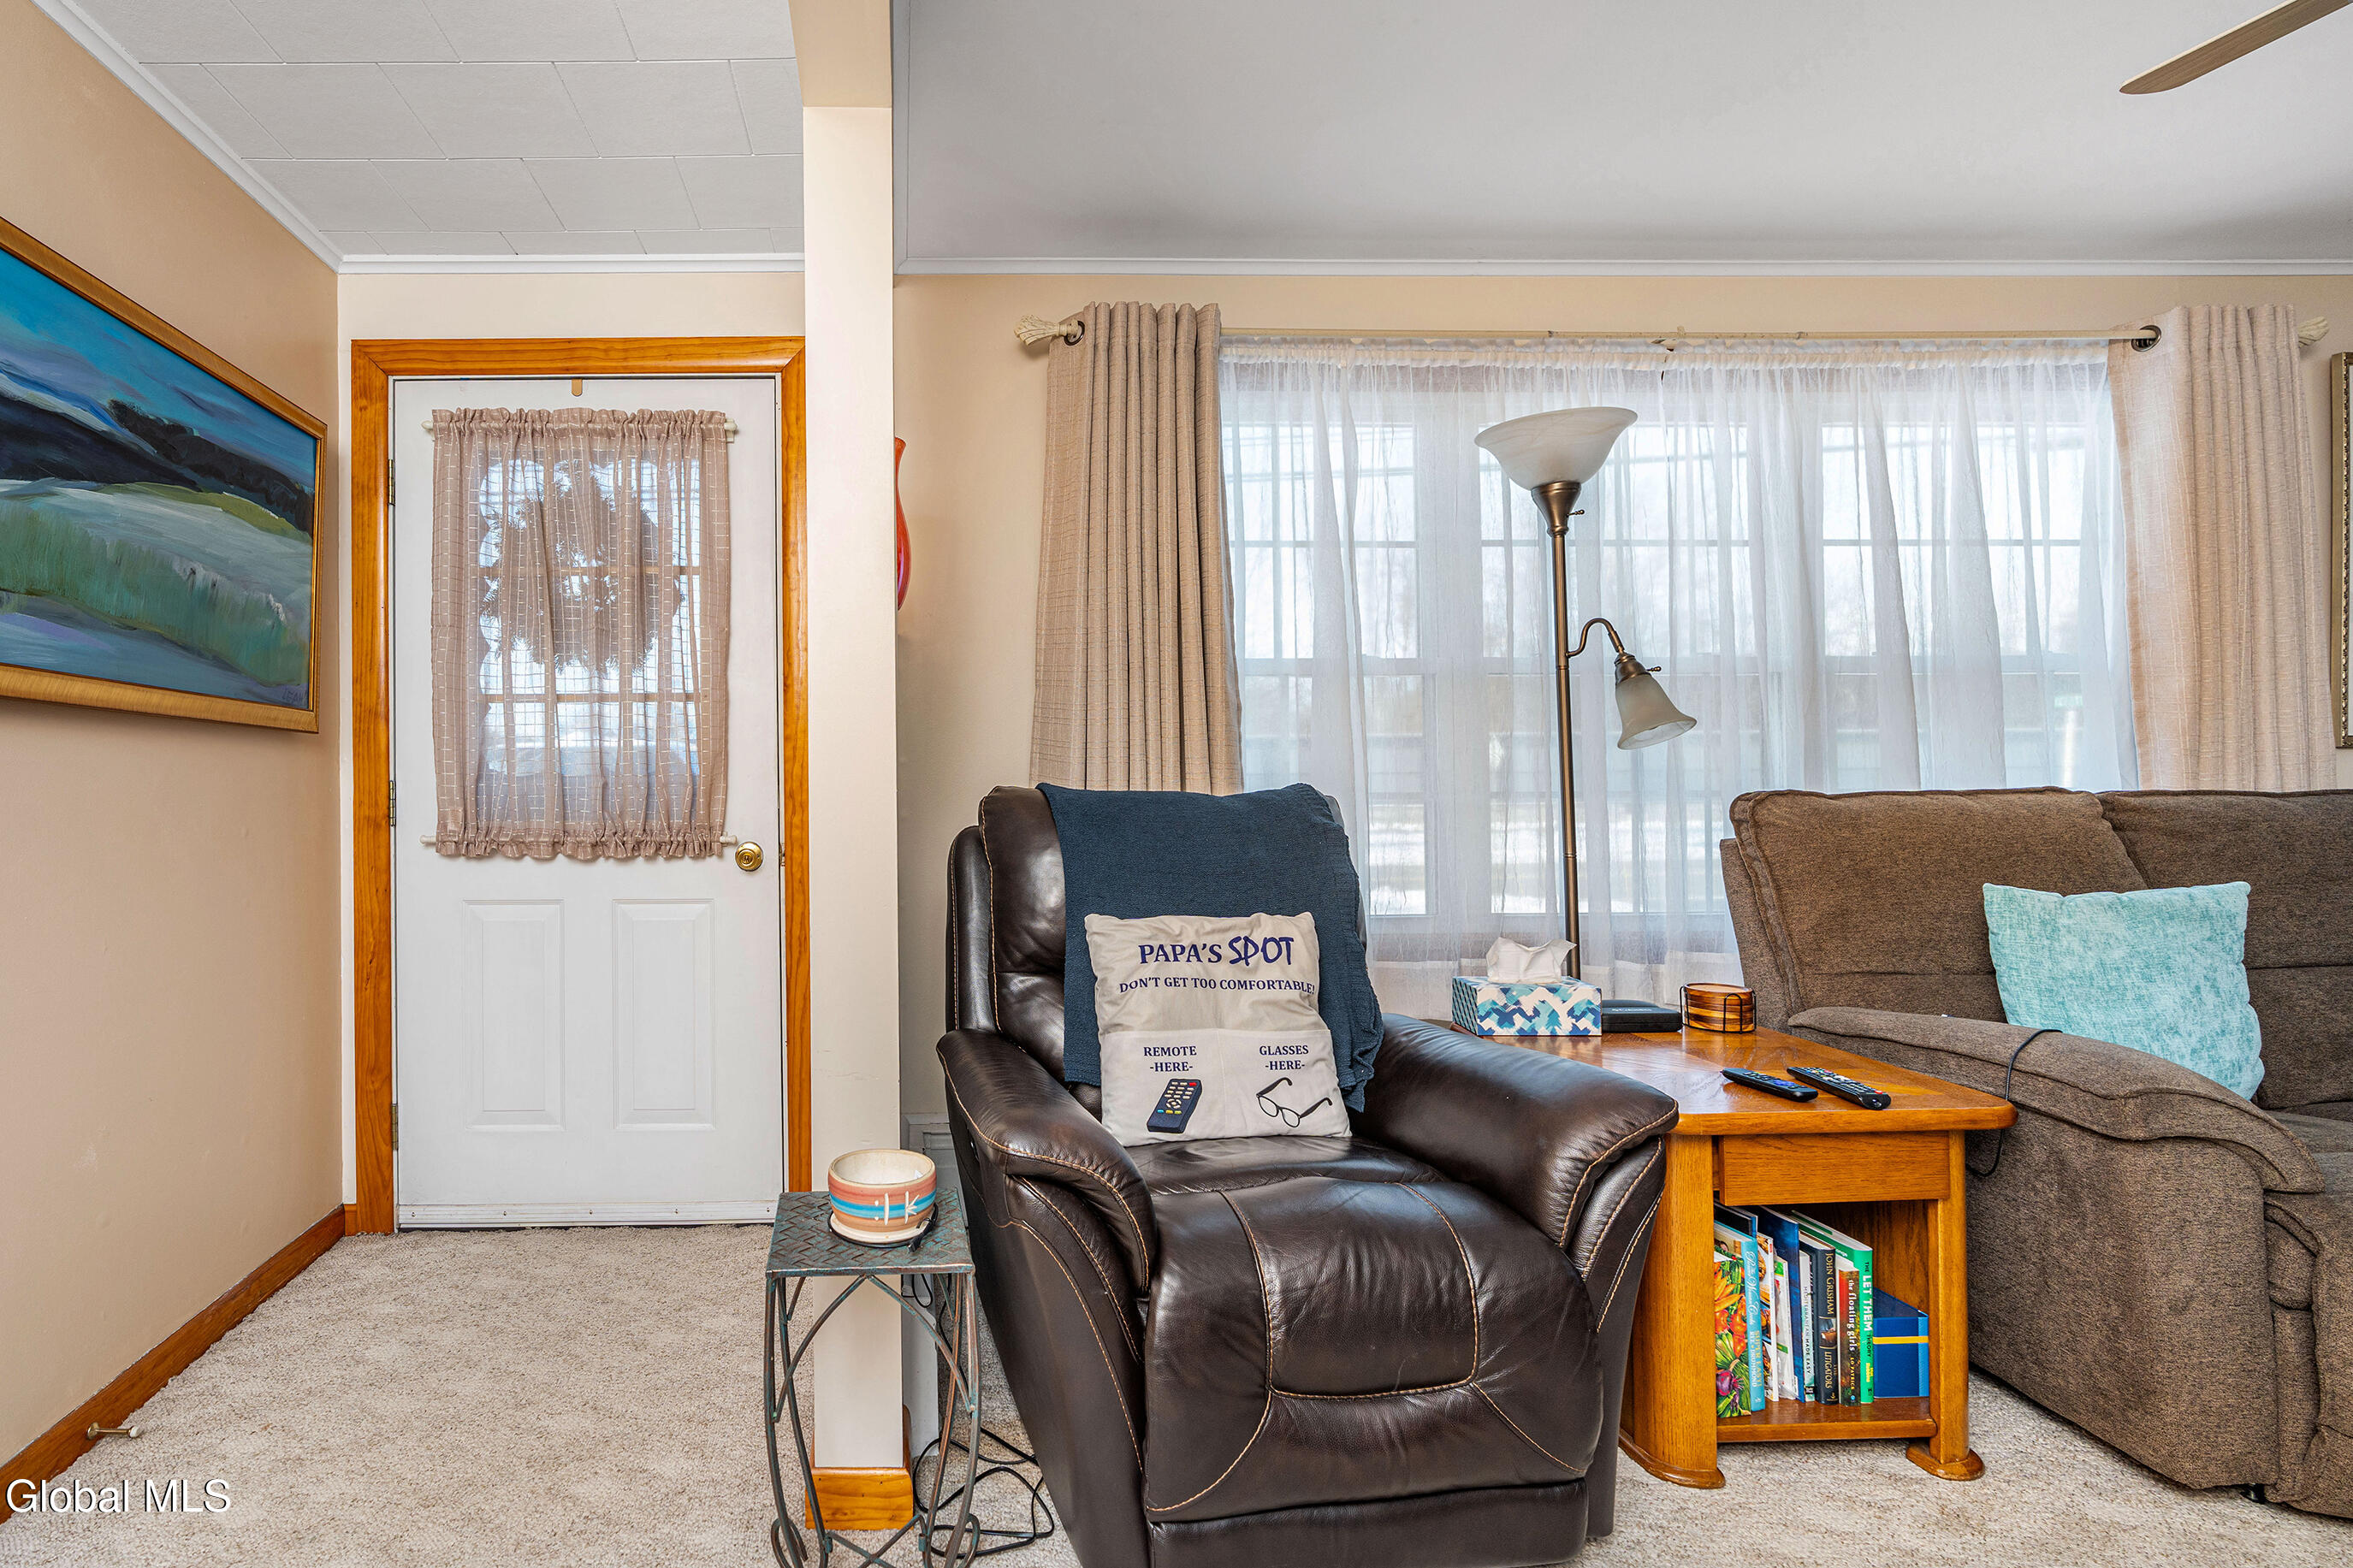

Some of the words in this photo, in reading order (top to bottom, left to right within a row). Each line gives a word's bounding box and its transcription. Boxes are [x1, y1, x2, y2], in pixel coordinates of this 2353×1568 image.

[1138, 944, 1222, 964] PAPA'S
[1228, 936, 1295, 966] SPOT
[1119, 977, 1160, 993] DON'T
[1165, 977, 1188, 988] GET
[1191, 978, 1217, 990] TOO
[1219, 979, 1315, 995] COMFORTABLE!
[1143, 1045, 1197, 1056] REMOTE
[1259, 1044, 1309, 1056] GLASSES
[1149, 1062, 1194, 1072] -HERE-
[1265, 1060, 1305, 1070] -HERE-
[1825, 1252, 1834, 1275] JOHN
[1746, 1275, 1758, 1305] Woman
[1863, 1275, 1871, 1294] LET
[1826, 1277, 1834, 1315] GRISHAM
[1748, 1301, 1759, 1325] Cooks
[1846, 1293, 1857, 1328] floating
[1863, 1299, 1873, 1331] THEM
[1846, 1330, 1858, 1352] girls
[1824, 1352, 1833, 1388] LITIGATORS
[1850, 1357, 1855, 1365] LO
